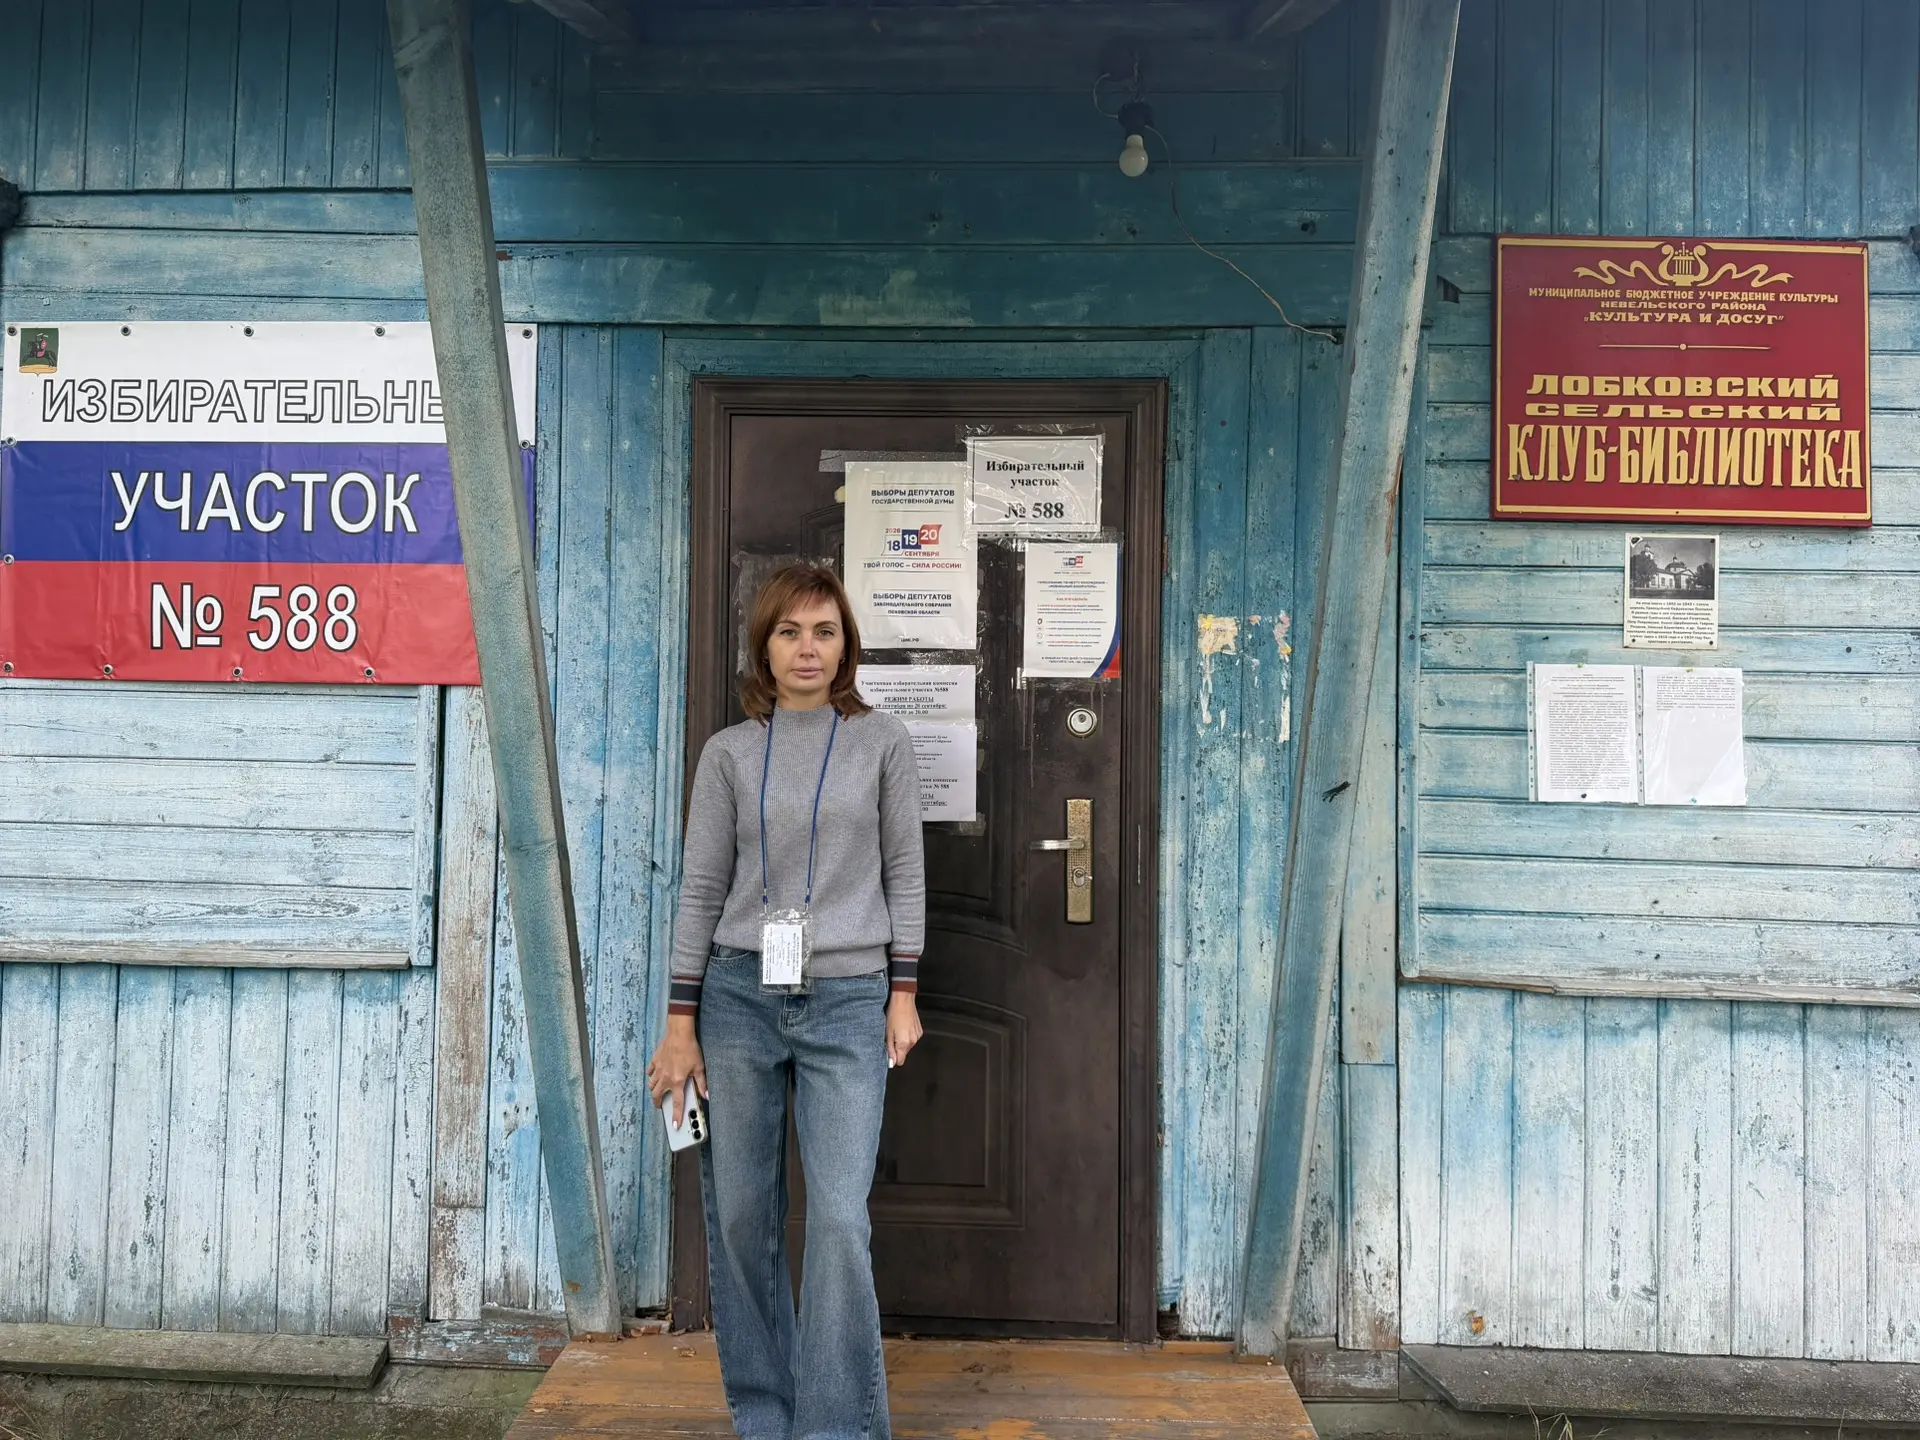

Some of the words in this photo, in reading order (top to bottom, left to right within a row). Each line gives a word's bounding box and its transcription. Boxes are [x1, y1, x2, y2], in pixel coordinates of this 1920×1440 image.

[1529, 288, 1621, 299] МУНИЦИПАЛЬНОЕ
[1625, 290, 1694, 300] БЮДЖЕТНОЕ
[1699, 291, 1776, 302] УЧРЕЖДЕНИЕ
[1779, 293, 1839, 303] КУЛЬТУРЫ
[1600, 301, 1706, 310] НЕВЕЛЬСКОГО
[1711, 301, 1767, 311] РАЙОНА
[1699, 313, 1712, 323] И
[1526, 373, 1839, 399] ЛОБКОВСКИЙ
[41, 378, 445, 424] ИЗБИРАТЕЛЬН
[1525, 402, 1841, 421] СЕЛЬСКИЙ
[1507, 423, 1864, 489] КЛУБ-БИБЛИОТЕКА
[986, 460, 1085, 475] Избирательный
[1010, 478, 1060, 489] участок
[871, 489, 906, 497] ВЫБОРЫ
[907, 489, 955, 497] ДЕПУТАТОВ
[110, 469, 421, 535] УЧАСТОК
[1004, 502, 1026, 518] №
[1032, 502, 1064, 519] 588
[887, 540, 901, 551] 18
[904, 534, 918, 546] 19
[920, 529, 938, 541] 20
[907, 593, 952, 601] ДЕПУТАТОВ
[149, 582, 225, 650] №
[247, 583, 360, 652] 588
